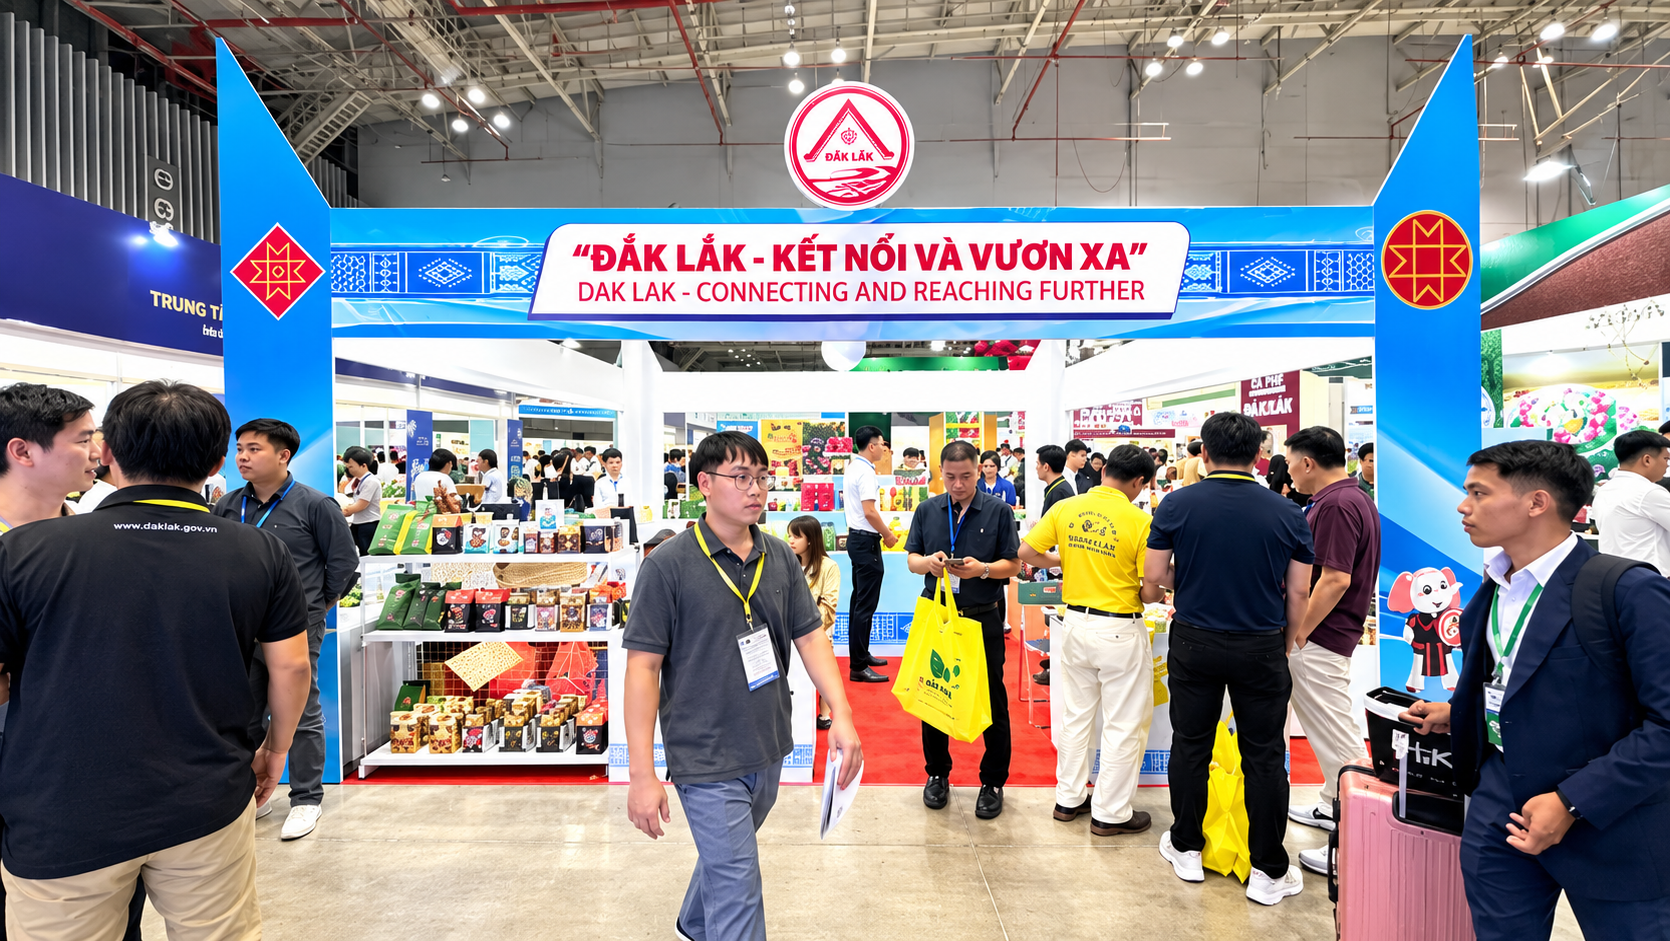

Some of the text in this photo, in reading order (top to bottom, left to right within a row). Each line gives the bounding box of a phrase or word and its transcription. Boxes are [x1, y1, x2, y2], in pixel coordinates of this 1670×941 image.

[677, 233, 747, 272] LẮK
[773, 233, 837, 272] KẾT
[914, 237, 964, 271] VÀ
[969, 239, 1073, 271] VƯƠN
[149, 289, 207, 317] TRUNG
[578, 282, 626, 302] DAK
[633, 282, 677, 302] LAK
[697, 281, 848, 302] CONNECTING
[855, 281, 907, 302] AND
[914, 281, 1032, 301] REACHING
[1040, 280, 1145, 301] FURTHER
[113, 521, 218, 533] www.daklak.gov.vn
